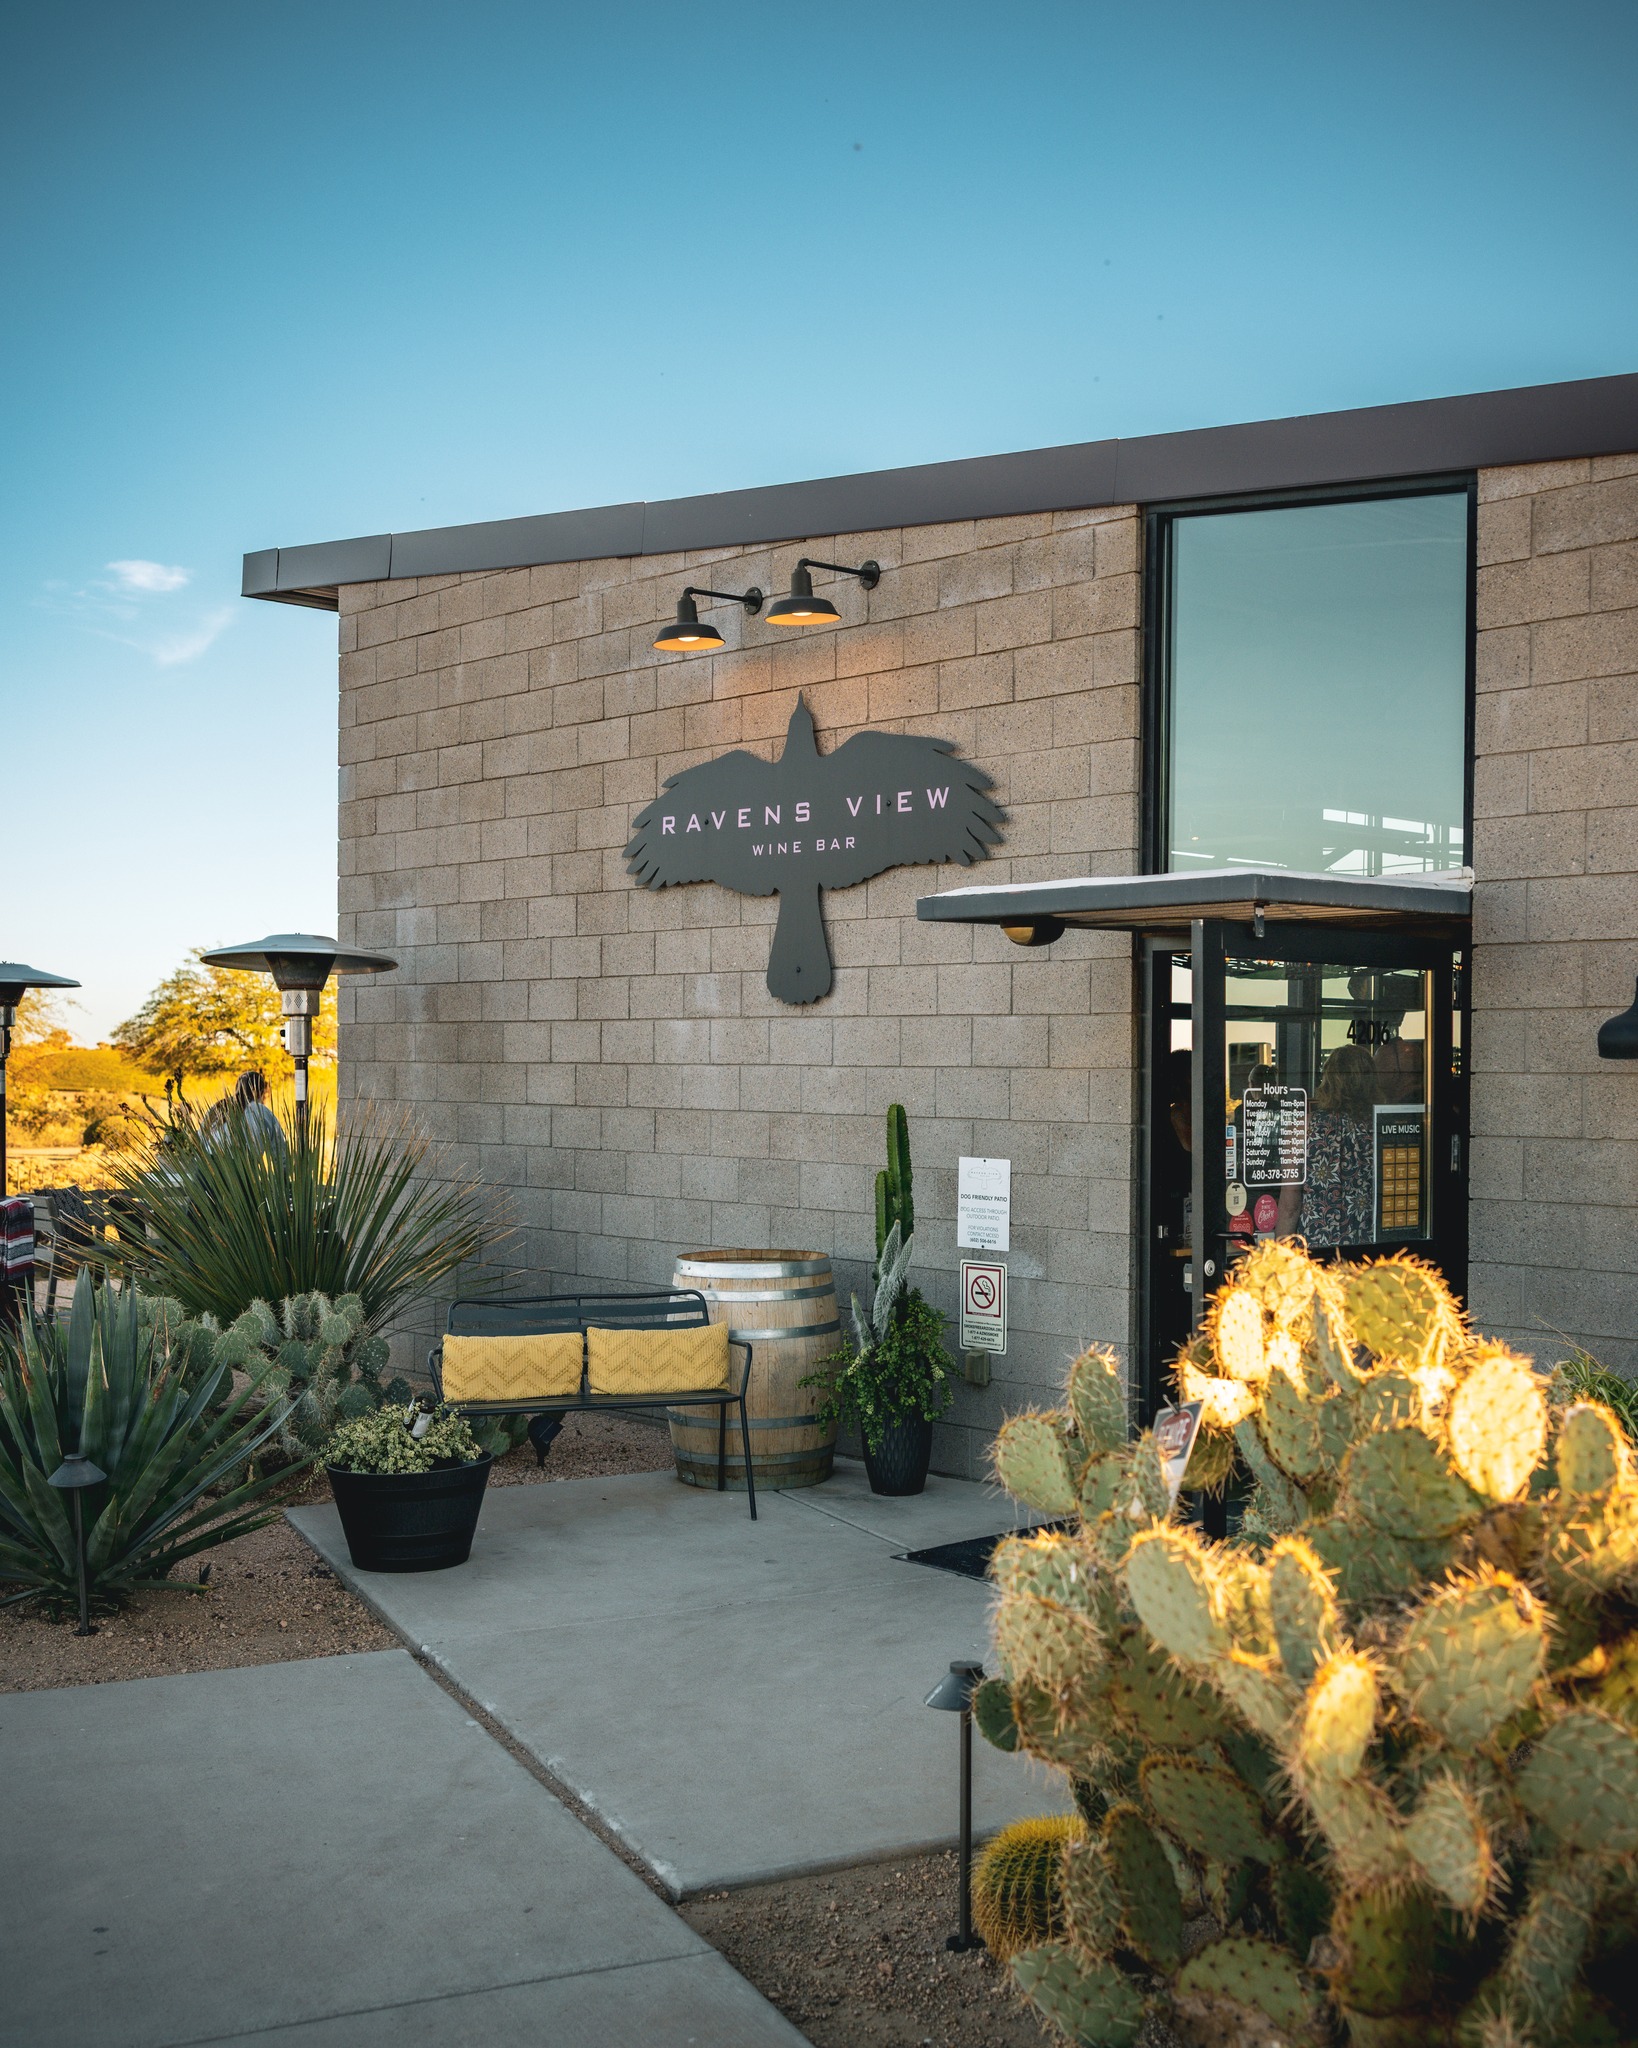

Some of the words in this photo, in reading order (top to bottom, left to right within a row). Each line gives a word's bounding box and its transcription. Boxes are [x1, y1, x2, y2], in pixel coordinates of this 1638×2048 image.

[661, 801, 811, 835] RAVENS
[845, 786, 950, 817] VIEW
[752, 841, 802, 856] WINE
[815, 836, 856, 851] BAR
[1263, 1082, 1289, 1095] Hours
[1246, 1099, 1268, 1109] Monday
[1280, 1099, 1305, 1109] 11am-8pm
[1381, 1124, 1397, 1134] LIVE
[1398, 1124, 1420, 1134] MUSIC
[1246, 1138, 1263, 1148] Friday
[1278, 1137, 1305, 1147] 11am-10pm
[1246, 1147, 1270, 1158] Saturday
[1278, 1147, 1305, 1157] 11am-10pm
[1246, 1157, 1266, 1167] Sunday
[1280, 1156, 1305, 1166] 11am-8pm
[1251, 1168, 1299, 1180] 480-378-3755
